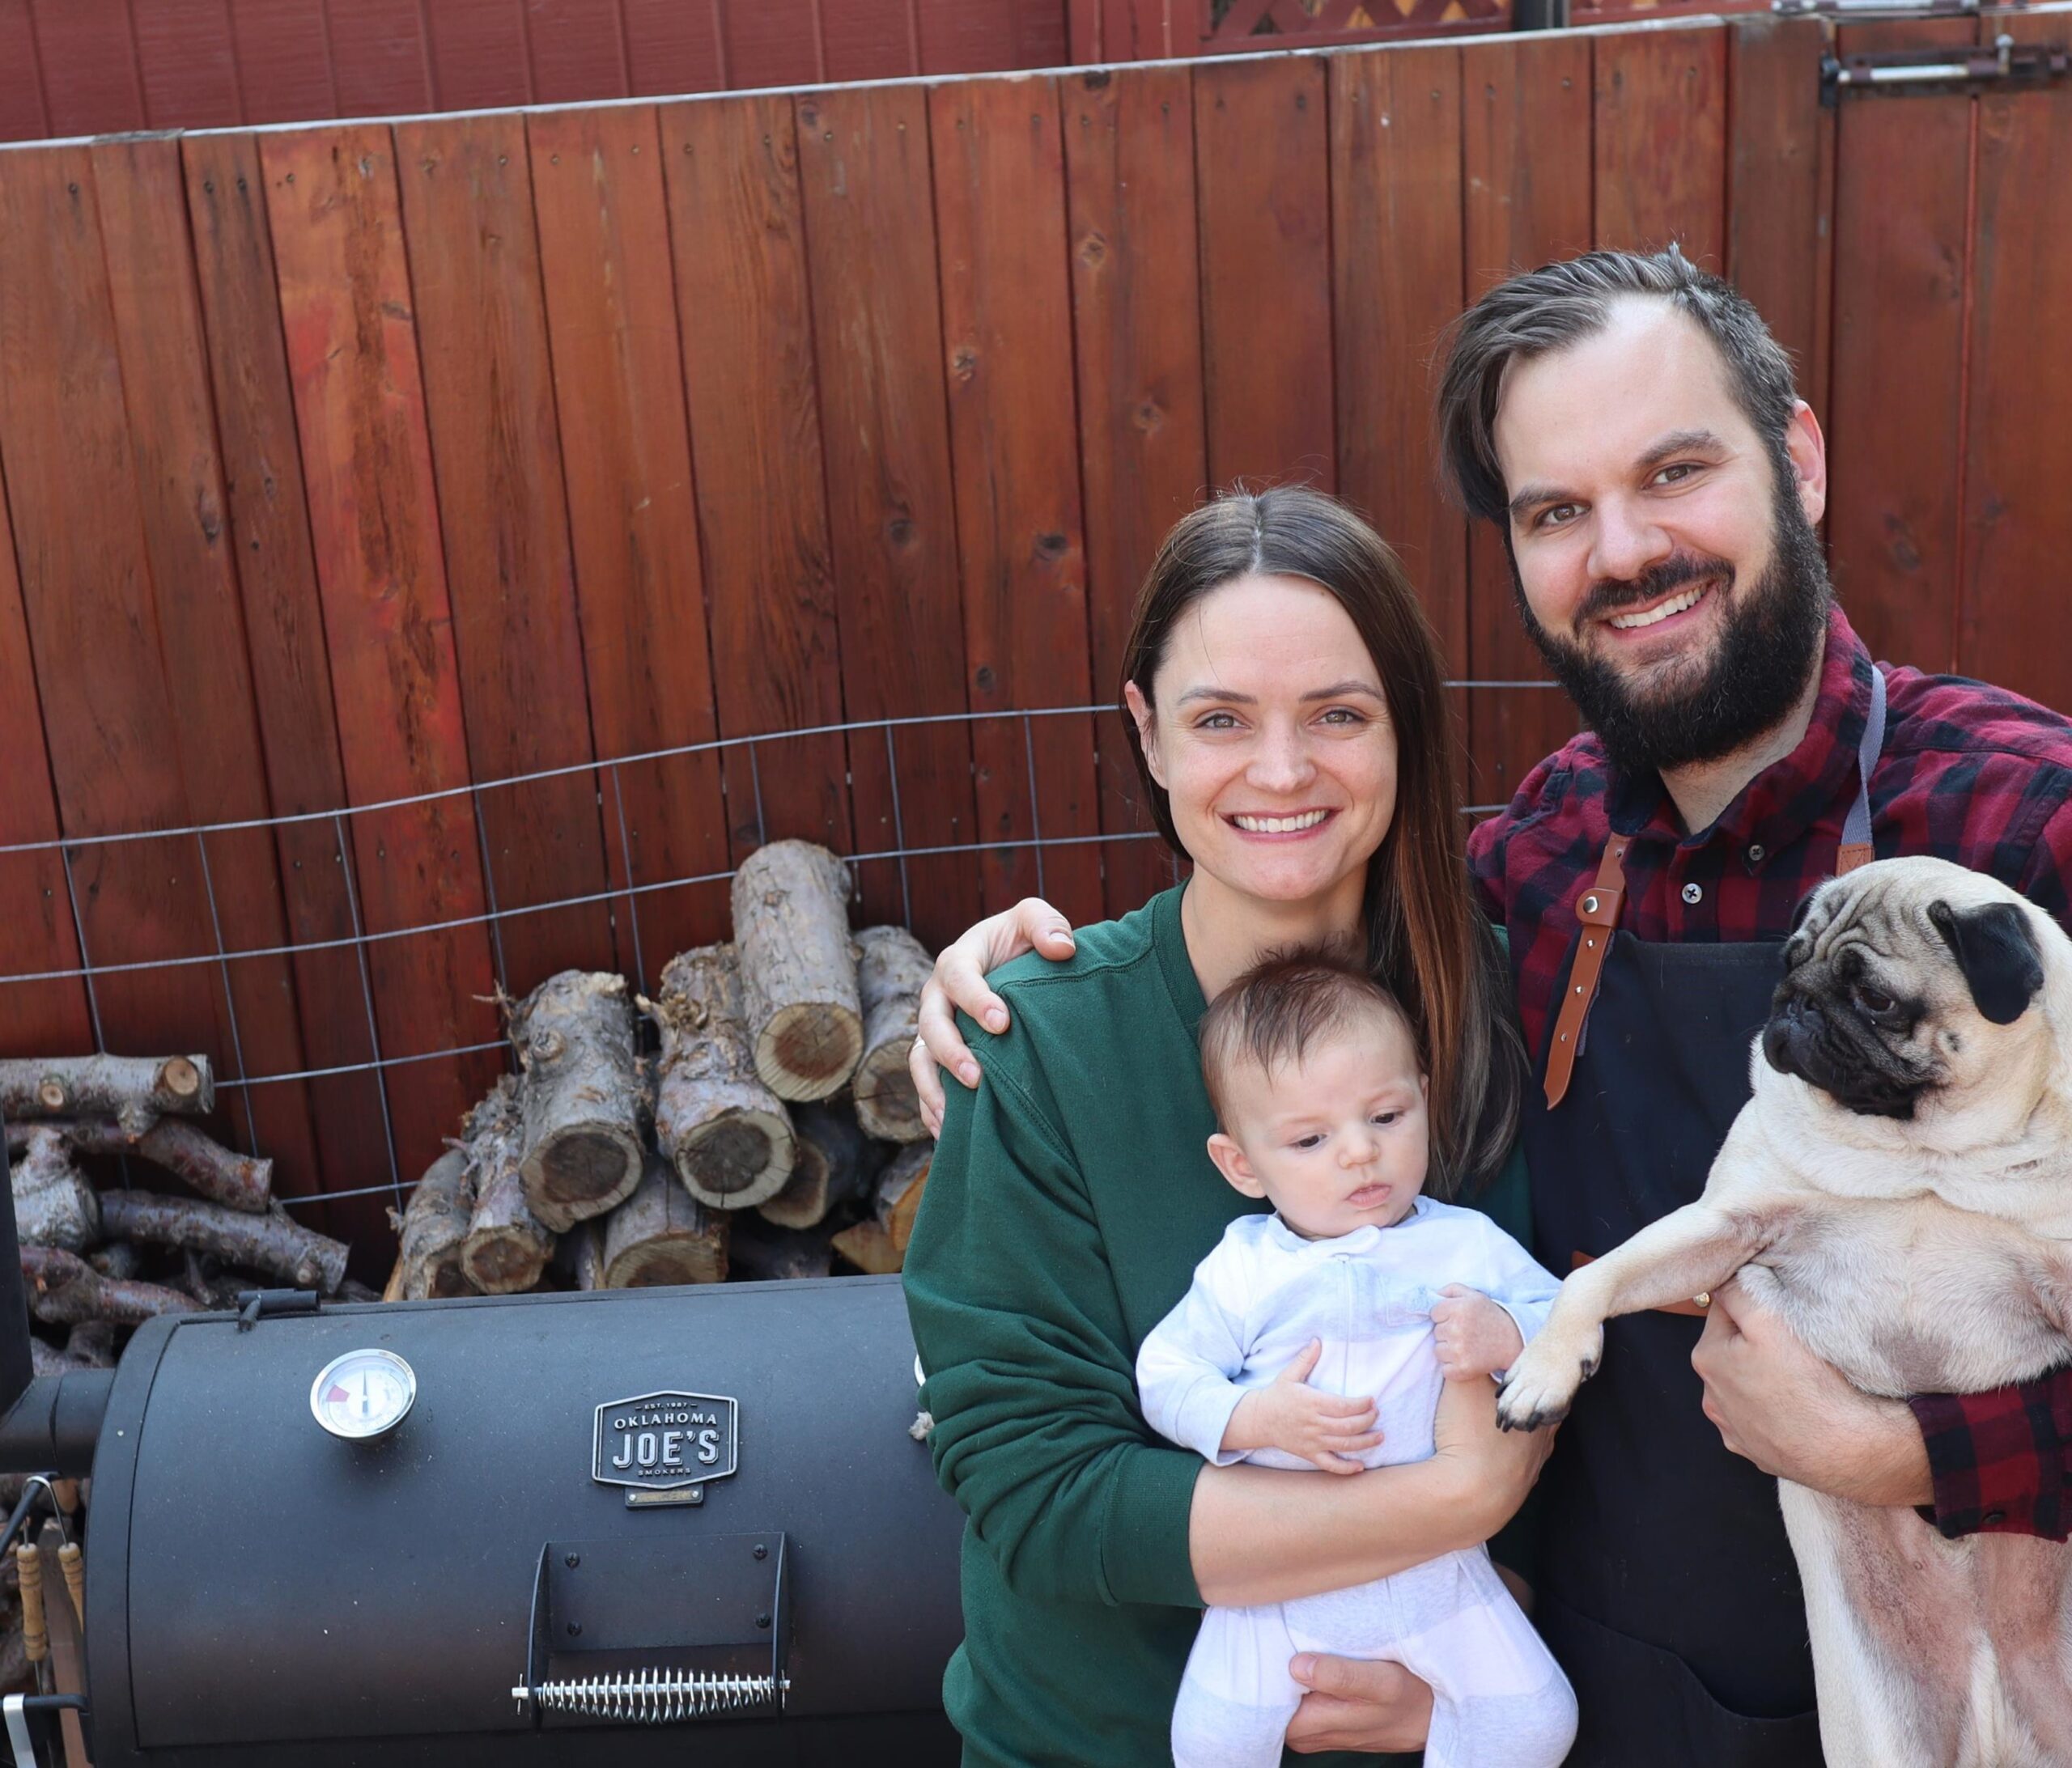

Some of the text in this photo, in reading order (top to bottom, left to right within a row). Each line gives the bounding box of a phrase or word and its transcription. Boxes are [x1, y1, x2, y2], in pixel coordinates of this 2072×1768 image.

[614, 1412, 717, 1429] OKLAHOMA
[613, 1430, 720, 1468] JOE'S
[638, 1467, 691, 1476] SMOKERS
